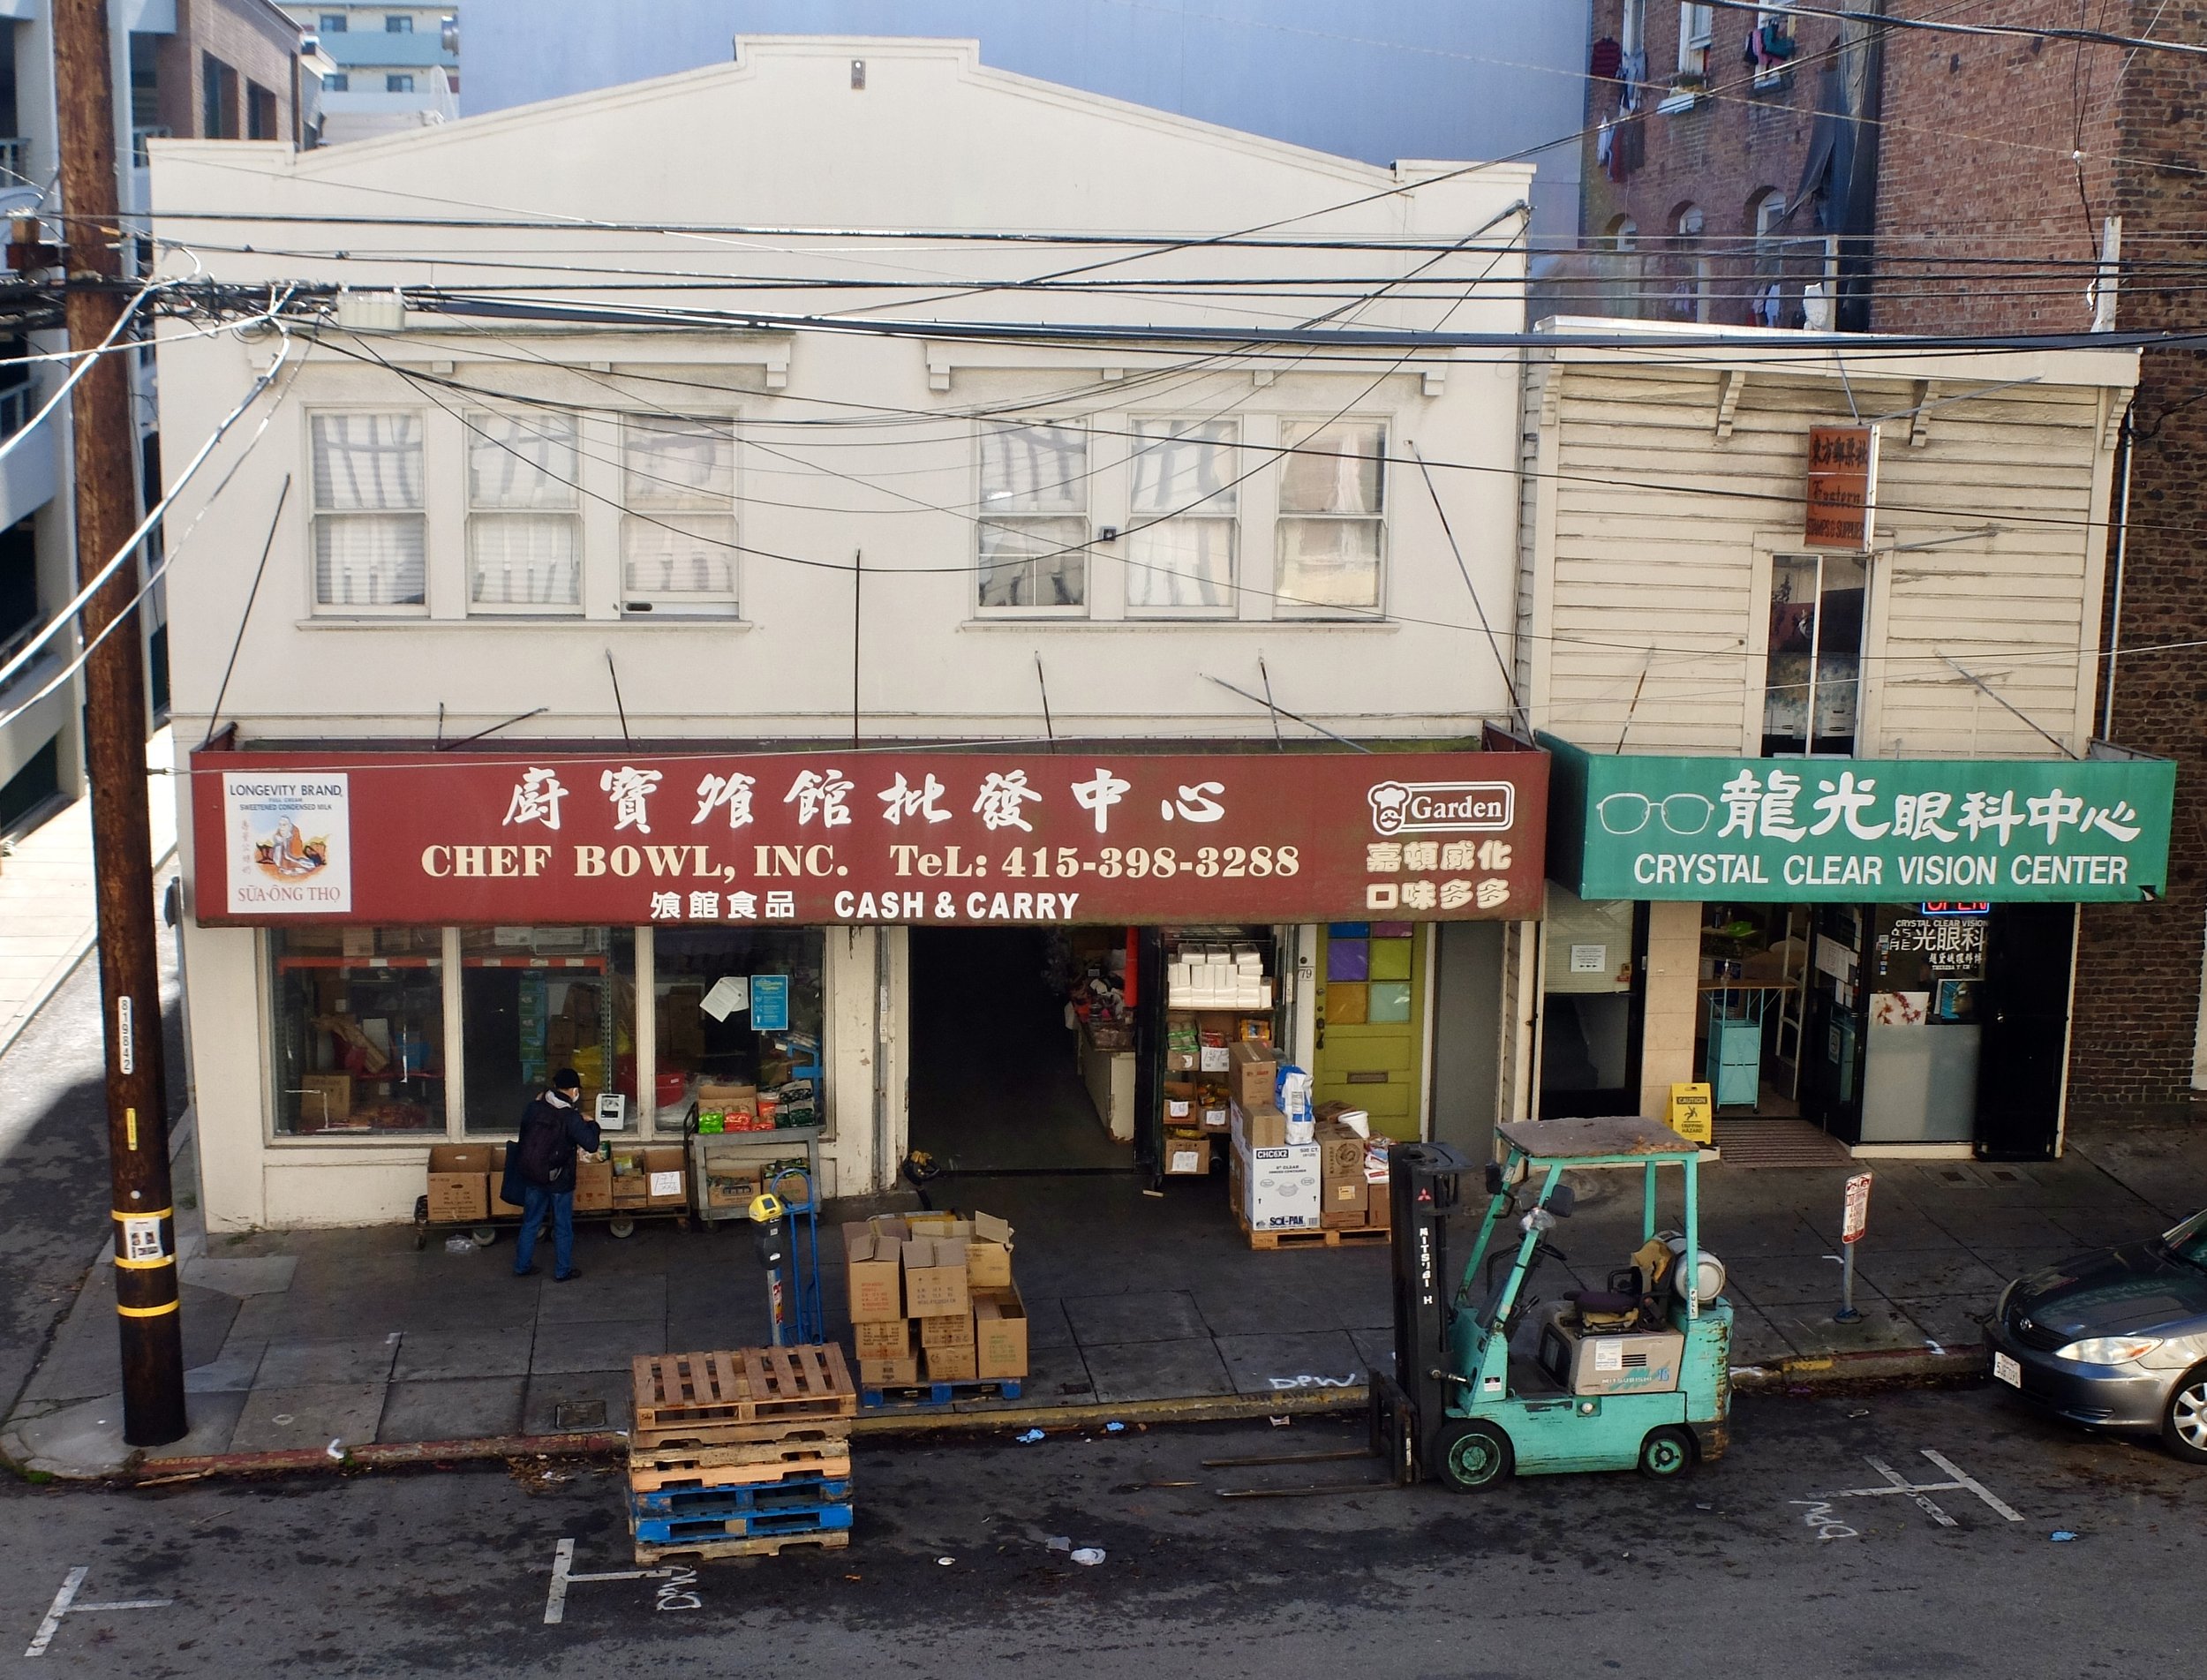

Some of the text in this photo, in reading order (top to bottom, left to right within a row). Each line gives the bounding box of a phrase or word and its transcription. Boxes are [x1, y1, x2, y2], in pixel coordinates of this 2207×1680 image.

[230, 784, 342, 796] LONGEVITY BRAND
[1412, 795, 1503, 819] Garden
[1718, 769, 2140, 847] 龍光眼科中心
[422, 845, 1299, 883] CHEF BOWL, INC. TeL: 415-398-3288
[1367, 840, 1511, 871] 嘉頓威化
[1634, 853, 2128, 885] CRYSTAL CLEAR VISION CENTER
[307, 886, 341, 903] THỌ
[835, 891, 1080, 920] CASH & CARRY
[1367, 878, 1510, 909] 口味多多
[1962, 919, 1988, 928] VISION
[1269, 1373, 1355, 1389] DPW
